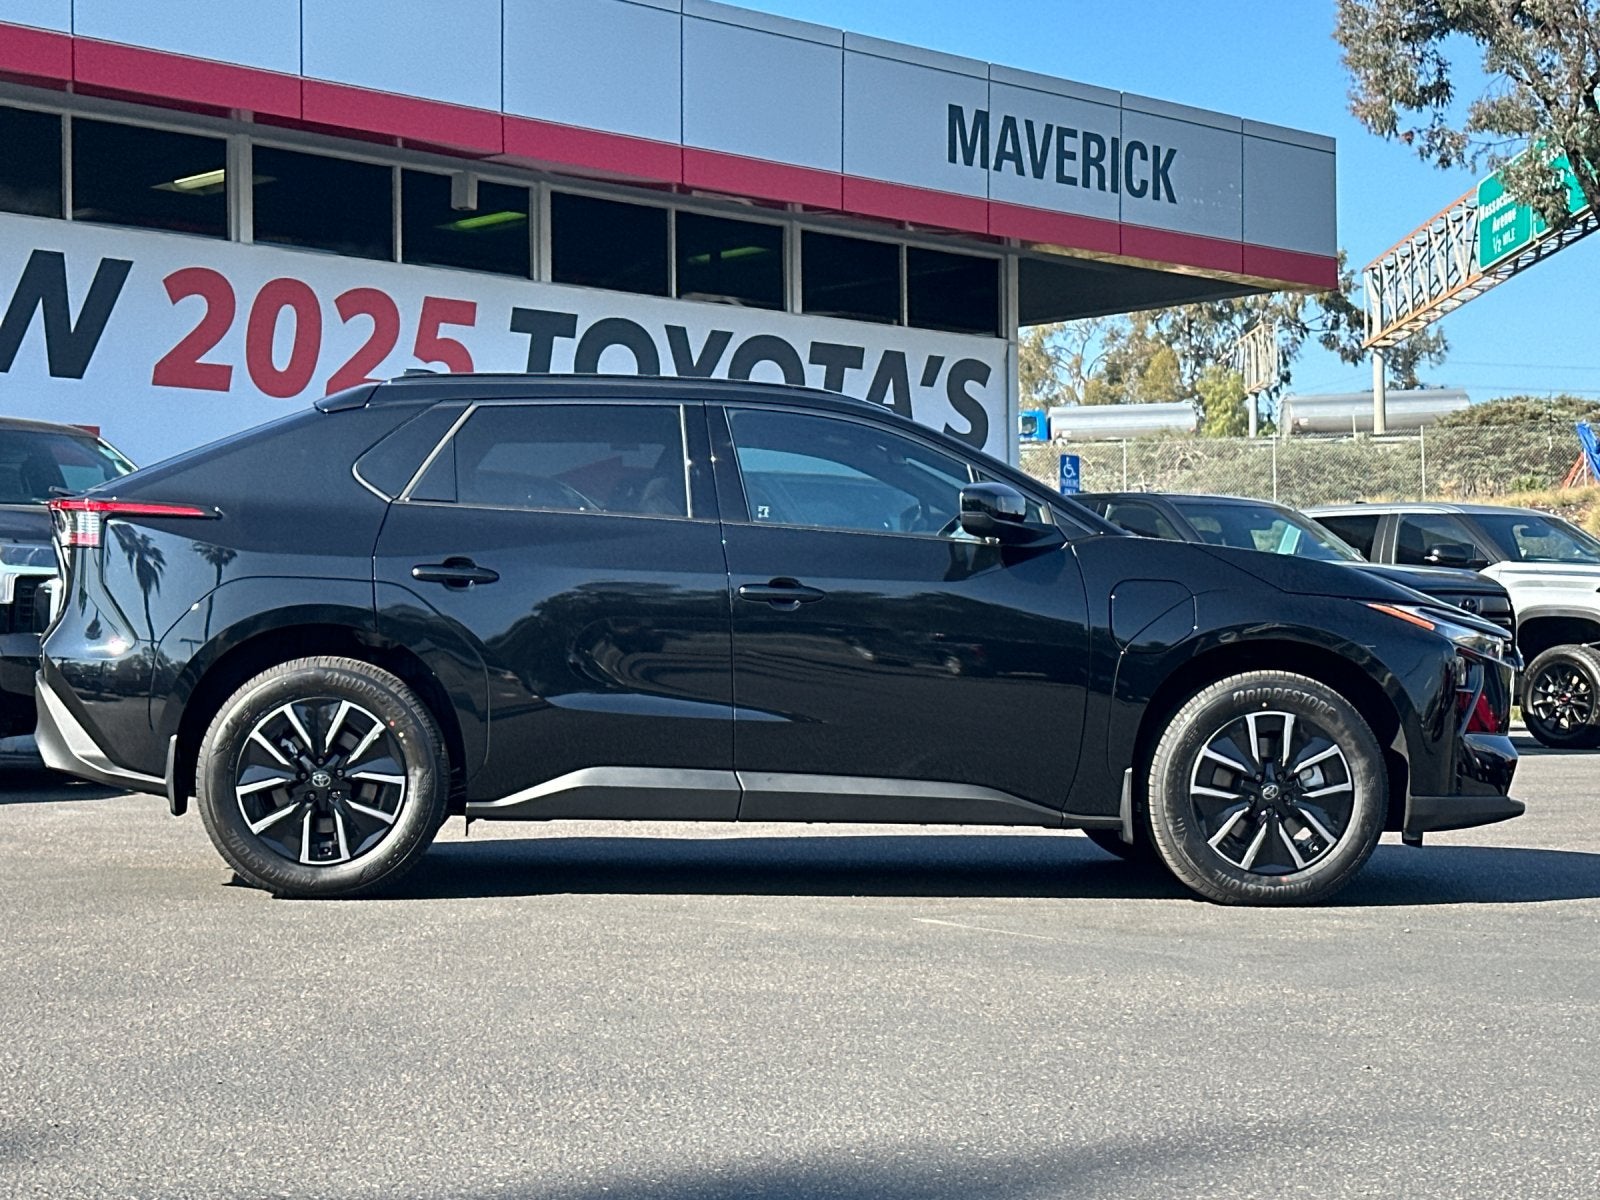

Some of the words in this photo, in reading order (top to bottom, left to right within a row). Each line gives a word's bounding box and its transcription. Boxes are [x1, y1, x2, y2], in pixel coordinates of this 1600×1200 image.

[948, 103, 1178, 204] MAVERICK
[152, 267, 478, 398] 2025
[1232, 687, 1337, 715] BRIDGESTONE
